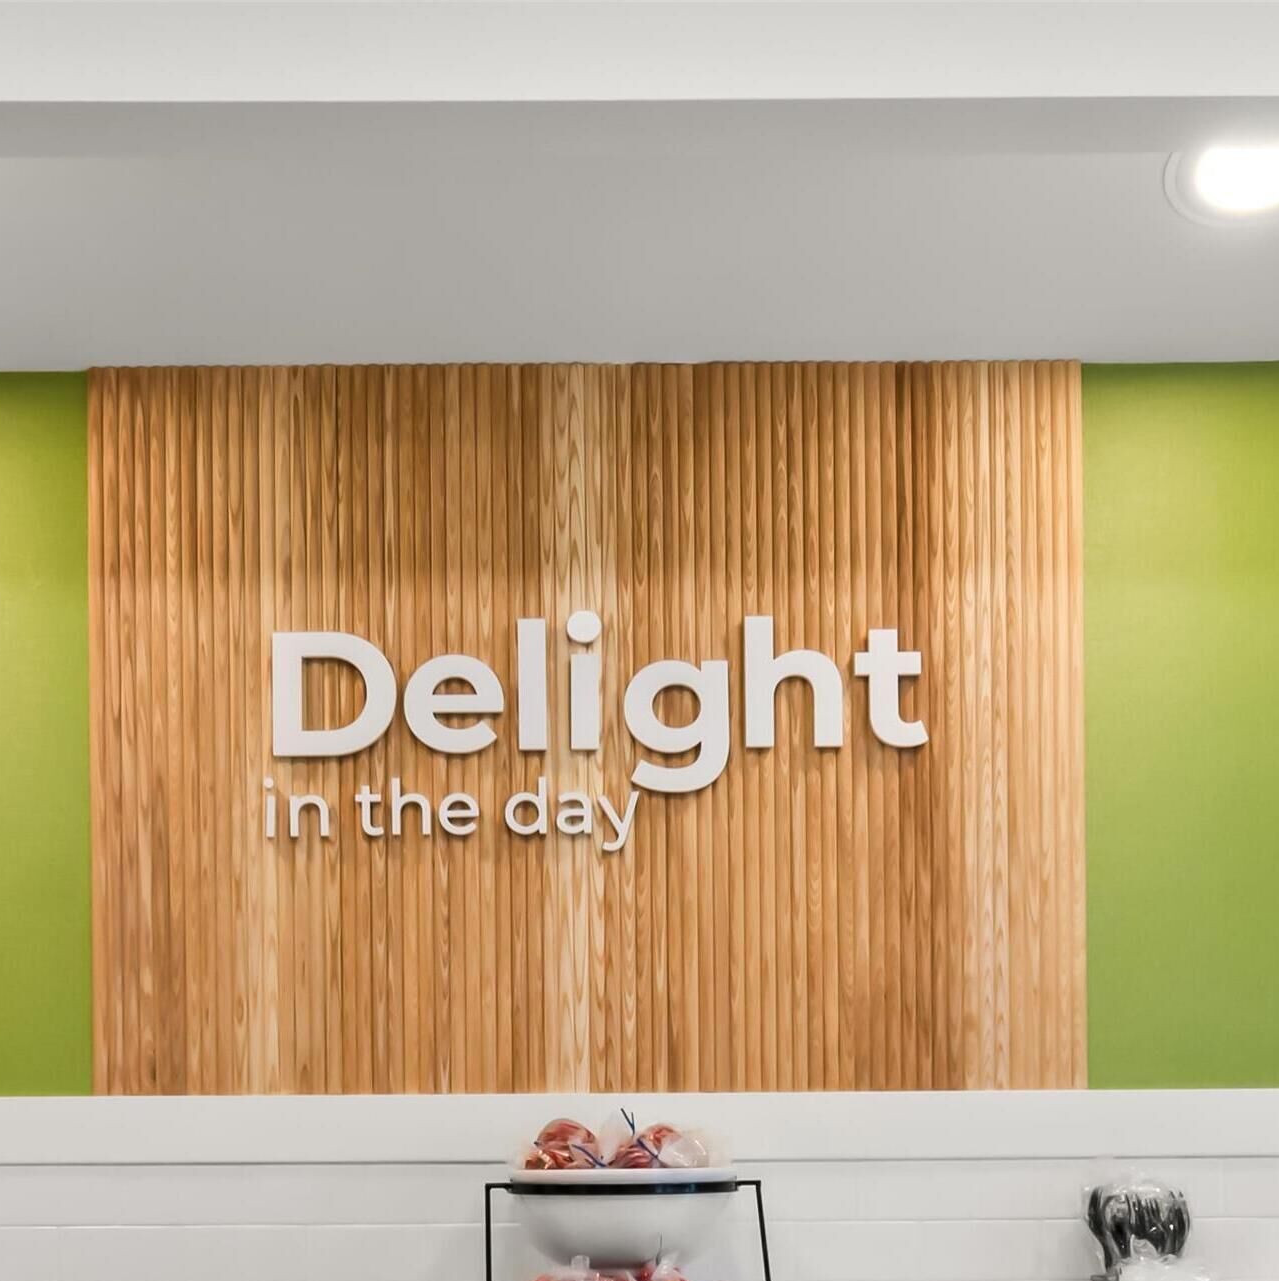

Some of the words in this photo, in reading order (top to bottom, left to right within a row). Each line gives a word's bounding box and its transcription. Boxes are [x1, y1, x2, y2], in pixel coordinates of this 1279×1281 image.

[272, 610, 929, 793] Delight
[263, 776, 329, 838] in
[355, 776, 479, 836] the
[505, 776, 639, 851] day
